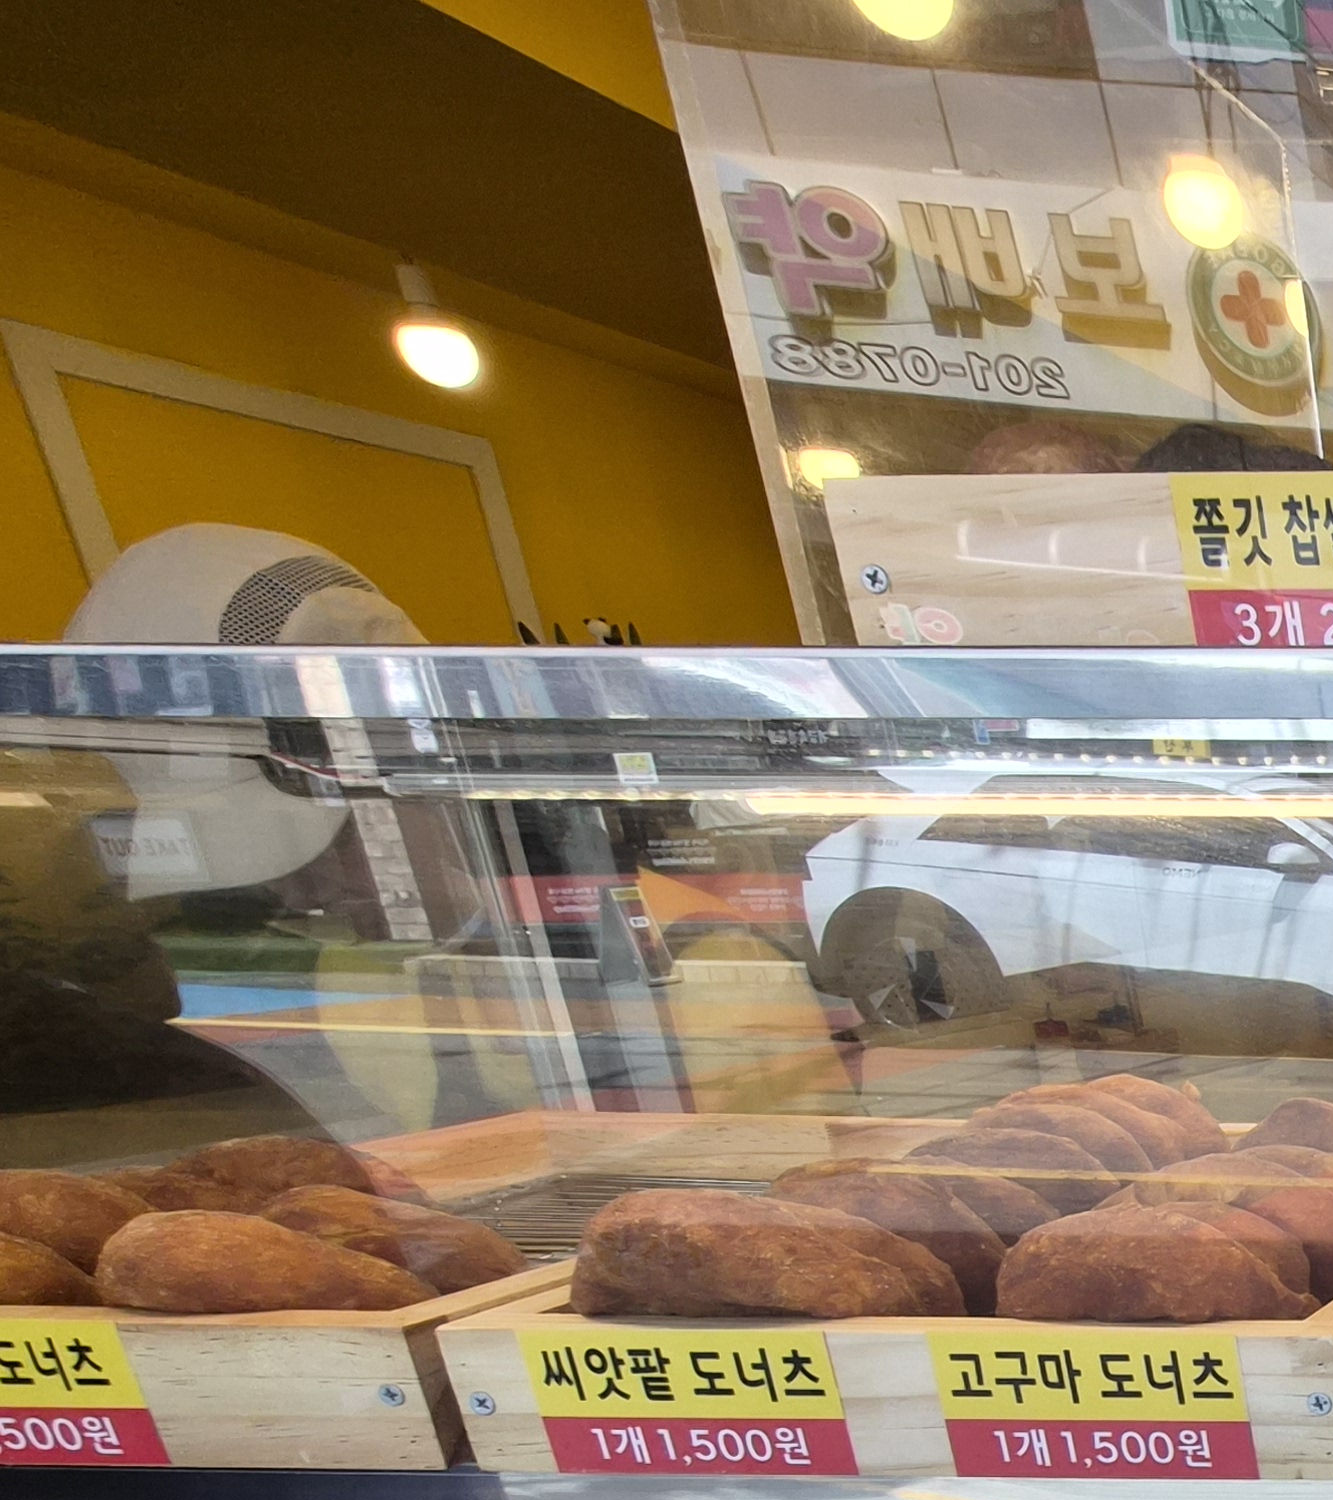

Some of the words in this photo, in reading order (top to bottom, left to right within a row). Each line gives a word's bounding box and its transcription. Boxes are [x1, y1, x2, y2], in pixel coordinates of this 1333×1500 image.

[1192, 494, 1273, 568] 쫄깃
[1233, 600, 1306, 647] 3개
[0, 1337, 112, 1392] 도너츠
[542, 1346, 672, 1403] 씨앗팥
[693, 1348, 826, 1404] 도너츠
[949, 1349, 1082, 1404] 고구마
[1100, 1350, 1235, 1405] 도너츠
[590, 1427, 652, 1465] 1개
[659, 1427, 811, 1468] 1,500원
[993, 1429, 1050, 1467] 1개
[1058, 1429, 1214, 1469] 1,500원
